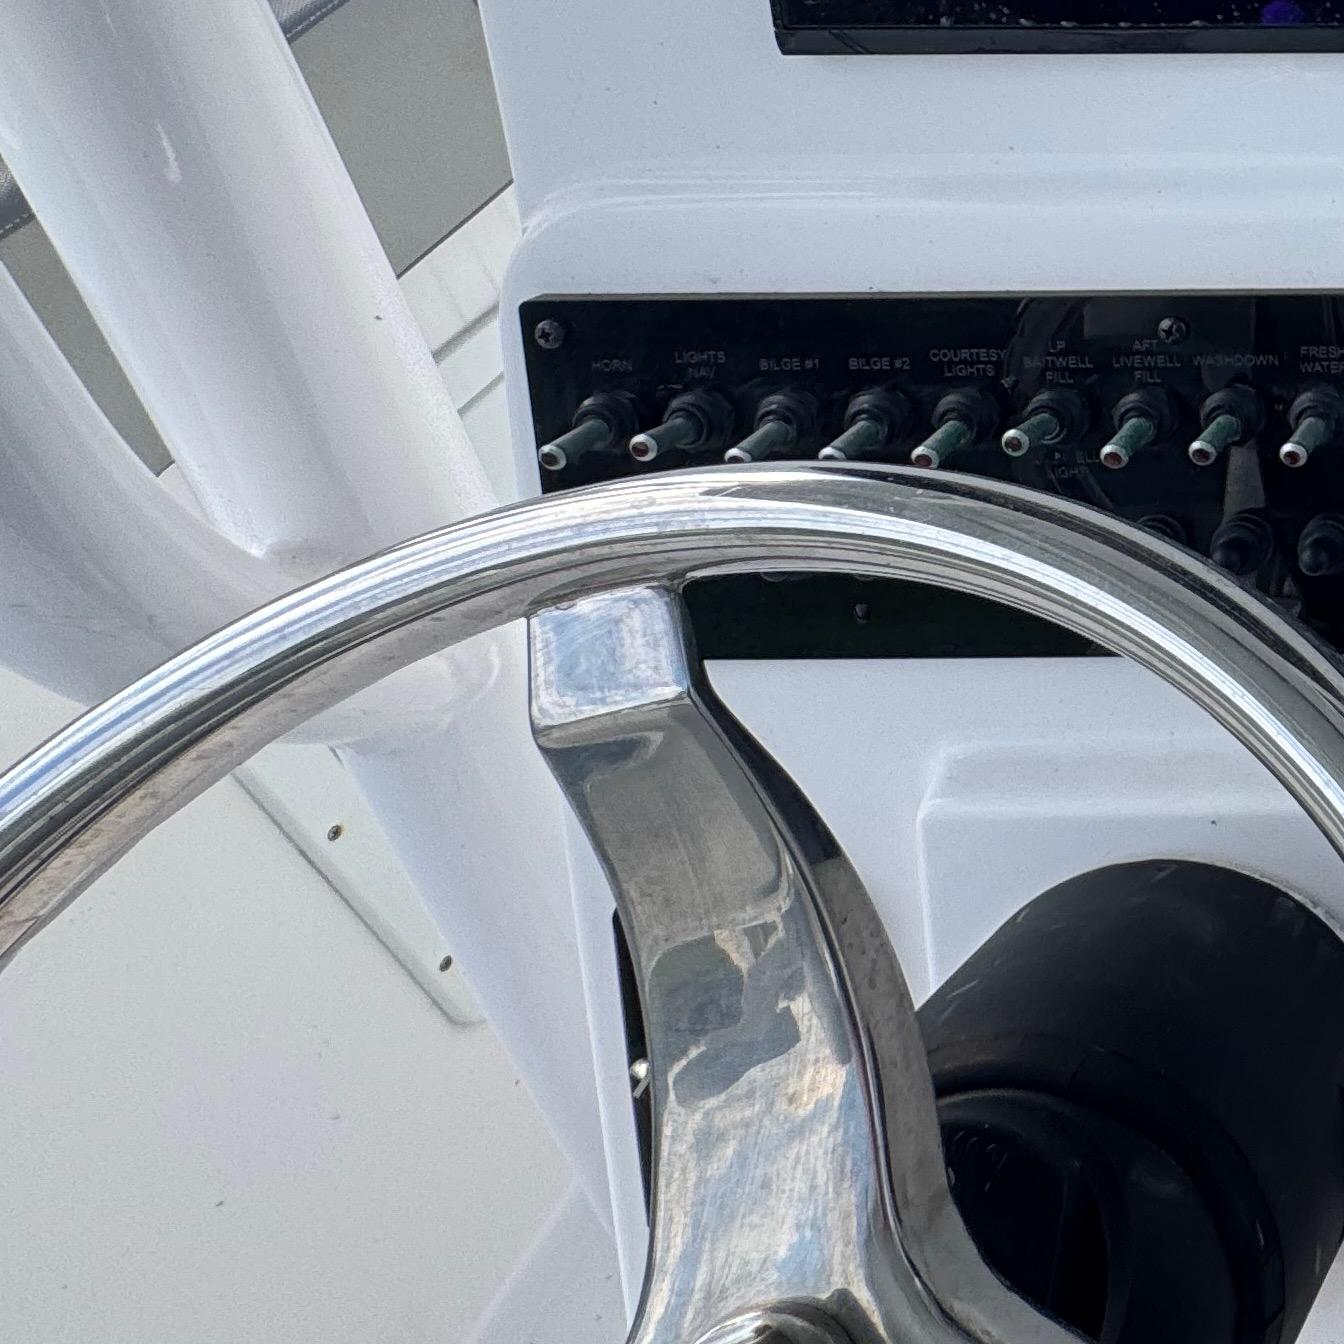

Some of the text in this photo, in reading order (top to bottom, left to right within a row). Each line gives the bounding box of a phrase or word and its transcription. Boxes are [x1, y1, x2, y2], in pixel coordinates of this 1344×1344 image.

[1133, 339, 1158, 351] AFT
[674, 351, 726, 364] LIGHTS
[929, 349, 1008, 362] COURTESY
[1112, 355, 1181, 368] LIVEWELL
[1192, 355, 1280, 367] WASHDOWN
[591, 360, 633, 372] HORN
[759, 358, 820, 370] BILGE #1
[848, 356, 911, 370] BILGE #2
[945, 364, 995, 377] LIGHTS
[1046, 371, 1074, 383] FILL
[1135, 370, 1162, 383] FILL
